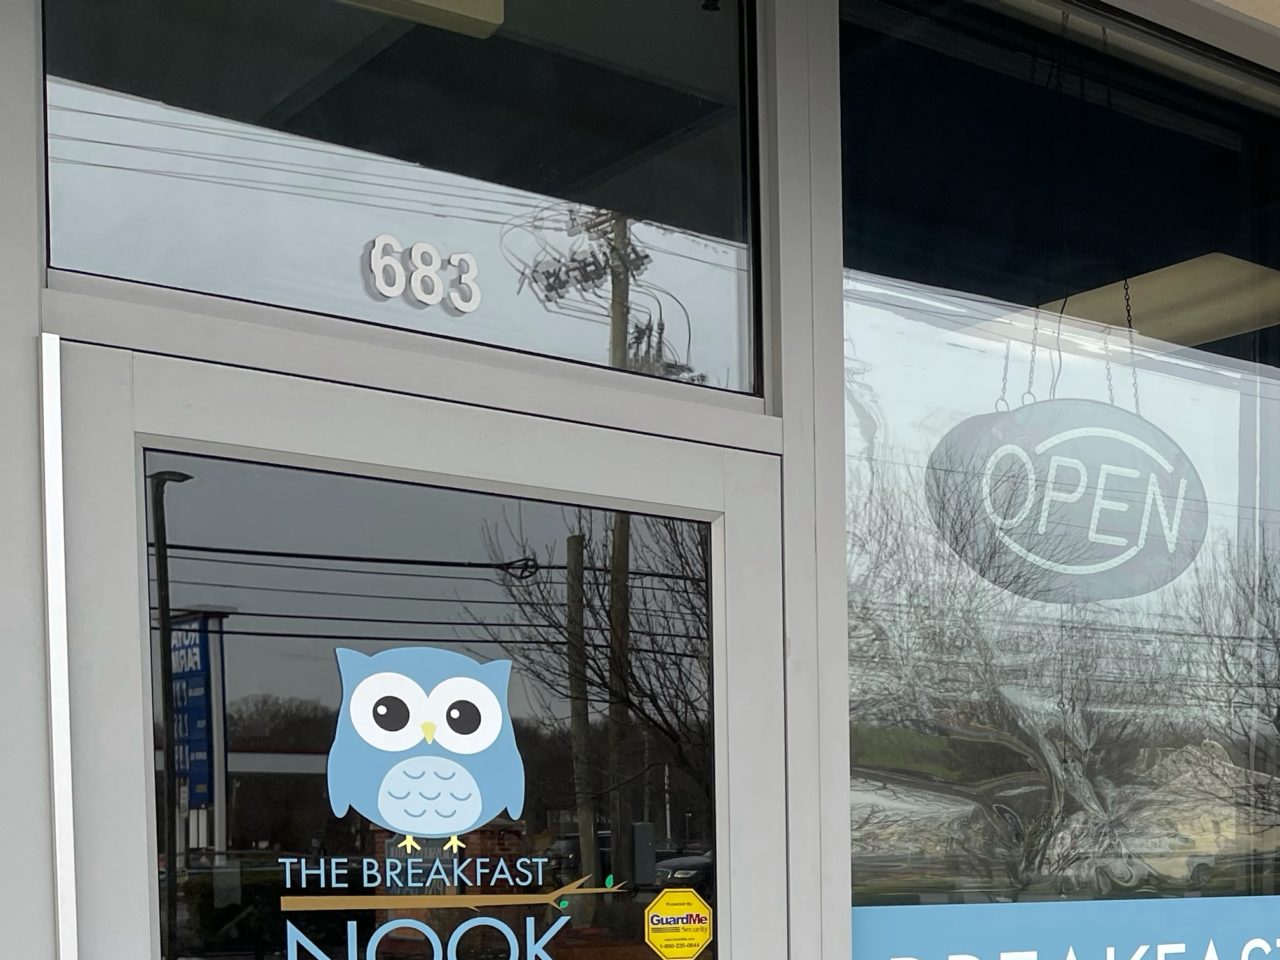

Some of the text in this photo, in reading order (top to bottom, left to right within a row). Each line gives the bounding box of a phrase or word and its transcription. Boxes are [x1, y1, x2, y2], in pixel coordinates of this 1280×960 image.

[369, 233, 481, 313] 683
[982, 444, 1187, 553] OPEN
[278, 857, 548, 888] THE BREAKFAST
[650, 913, 708, 926] GuardMe
[681, 926, 708, 934] Security
